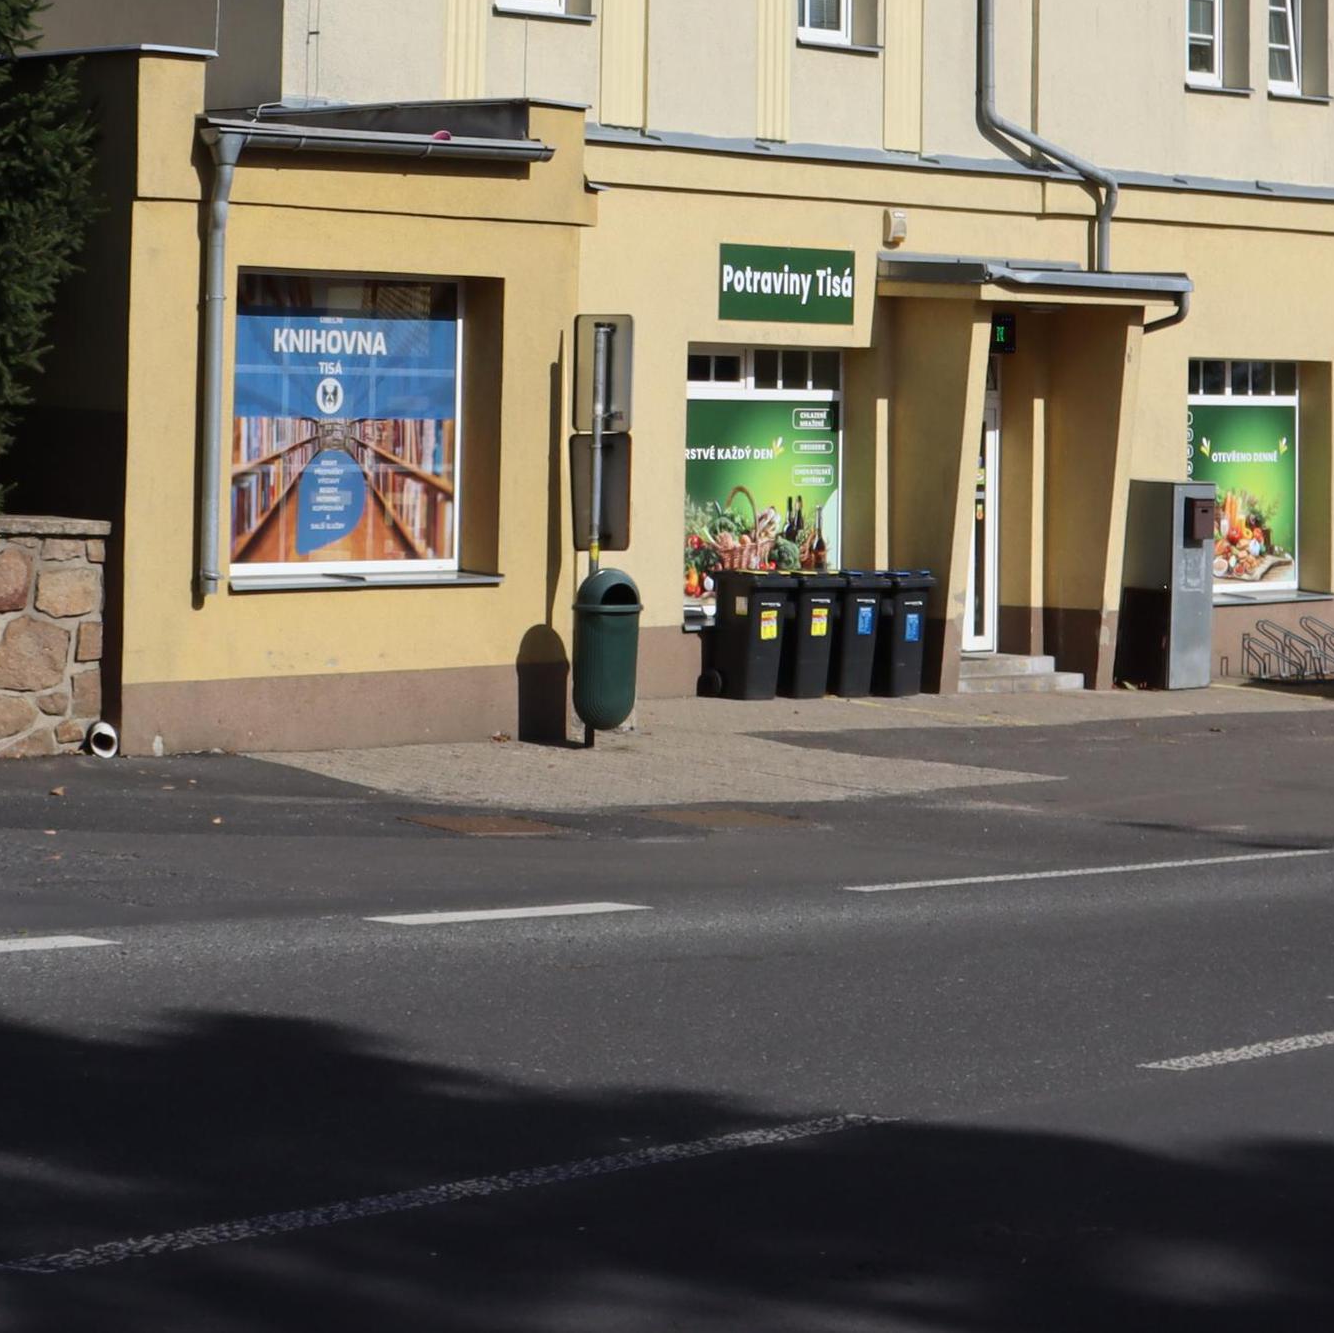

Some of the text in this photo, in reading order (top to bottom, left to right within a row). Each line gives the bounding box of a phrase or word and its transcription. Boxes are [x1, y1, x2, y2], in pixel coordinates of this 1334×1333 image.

[723, 264, 853, 304] Potraviny Tisá
[273, 328, 387, 355] KNIHOVNA
[318, 360, 342, 374] TISÁ
[717, 446, 752, 459] KAŽDÝ
[754, 448, 773, 459] DEN
[1211, 450, 1253, 462] OTEVŘENO
